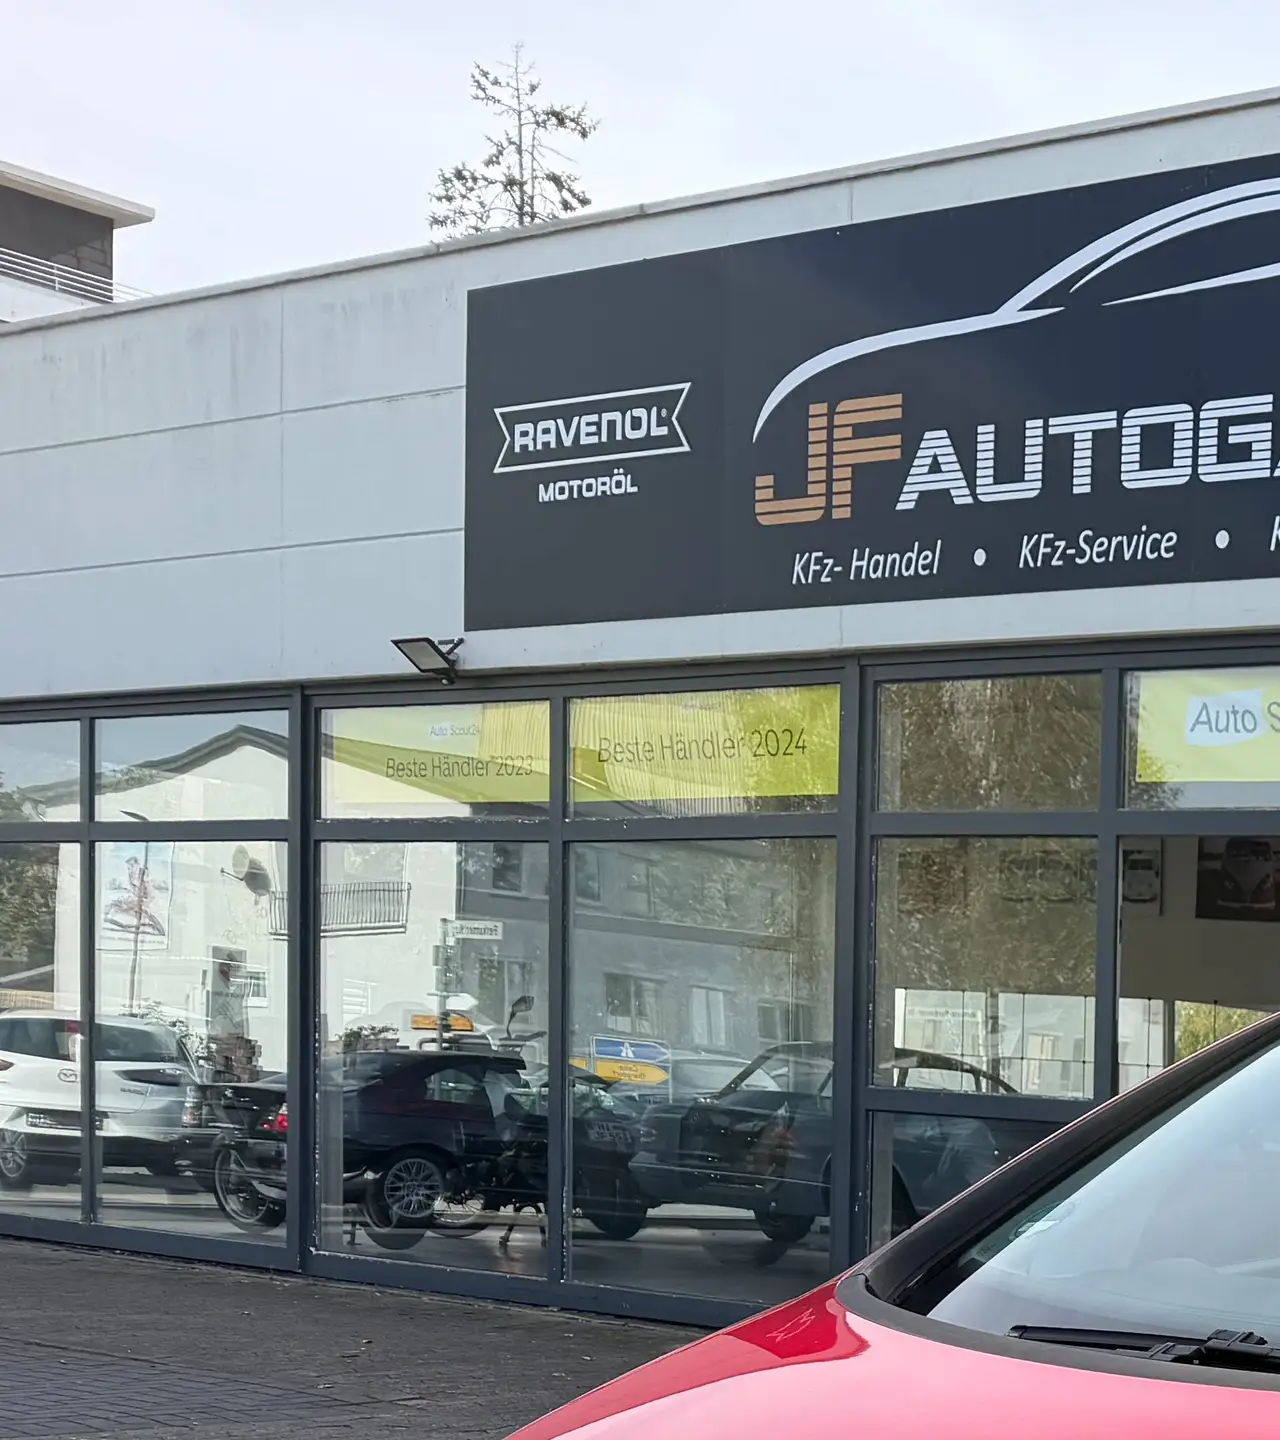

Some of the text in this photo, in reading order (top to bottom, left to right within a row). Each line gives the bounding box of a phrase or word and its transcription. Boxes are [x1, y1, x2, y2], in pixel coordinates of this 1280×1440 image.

[754, 393, 903, 526] JF
[538, 467, 639, 503] MOTORÖL
[850, 539, 942, 581] Handel
[1018, 524, 1178, 569] KFz-Service
[1190, 702, 1258, 734] Auto
[597, 728, 808, 763] Beste Händler 2024
[385, 754, 535, 779] Beste Händler 2023
